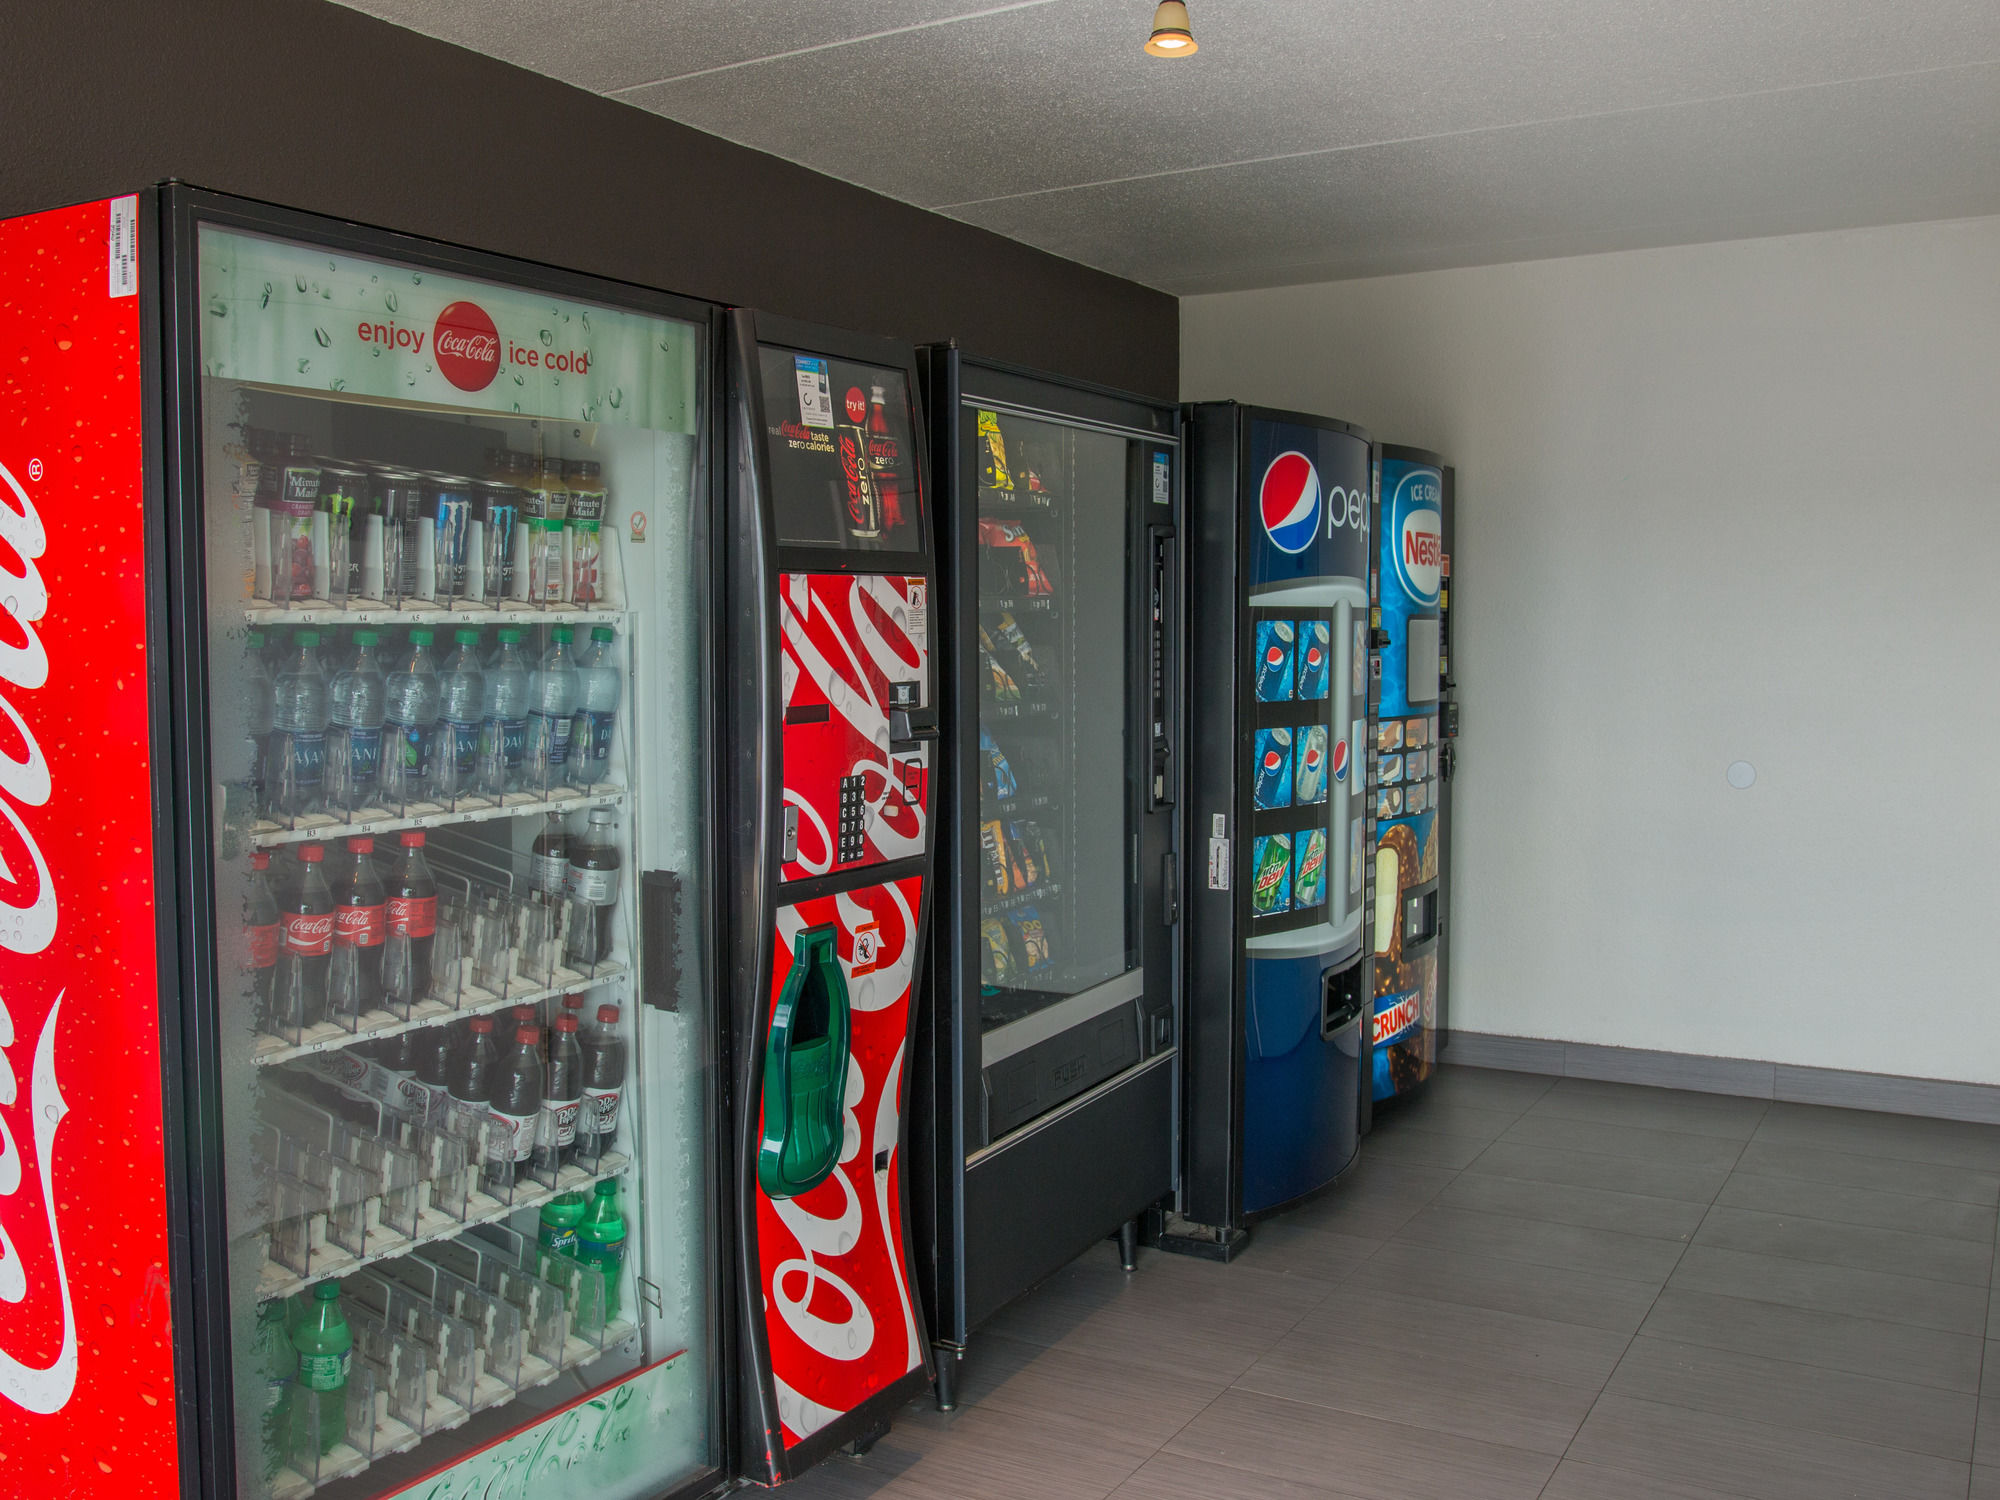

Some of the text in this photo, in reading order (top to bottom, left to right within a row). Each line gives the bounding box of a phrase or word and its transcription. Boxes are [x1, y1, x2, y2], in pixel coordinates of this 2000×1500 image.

[358, 321, 588, 375] enjoy Coca-Cola ice cold
[846, 400, 865, 412] try it!
[768, 425, 781, 436] real
[811, 432, 829, 442] taste
[789, 440, 835, 453] zero calories
[875, 457, 894, 465] zero
[839, 434, 864, 524] Coca-Cola
[858, 458, 870, 505] zero
[1411, 484, 1423, 501] ICE
[573, 507, 595, 517] Maid
[303, 614, 312, 622] A3
[359, 614, 367, 622] A4
[411, 614, 420, 622] A5
[842, 775, 866, 789] A 1 2
[842, 790, 865, 803] B 3 4
[842, 805, 865, 818] C 5 6
[414, 818, 423, 826] B5
[841, 820, 864, 833] D 7 8
[306, 829, 316, 837] B3
[362, 825, 371, 833] B4
[841, 834, 864, 848] E 9 0
[840, 852, 845, 863] F
[289, 918, 332, 935] Coca-Cola
[1373, 993, 1419, 1042] CRUNCH
[552, 1233, 577, 1249] Sprit
